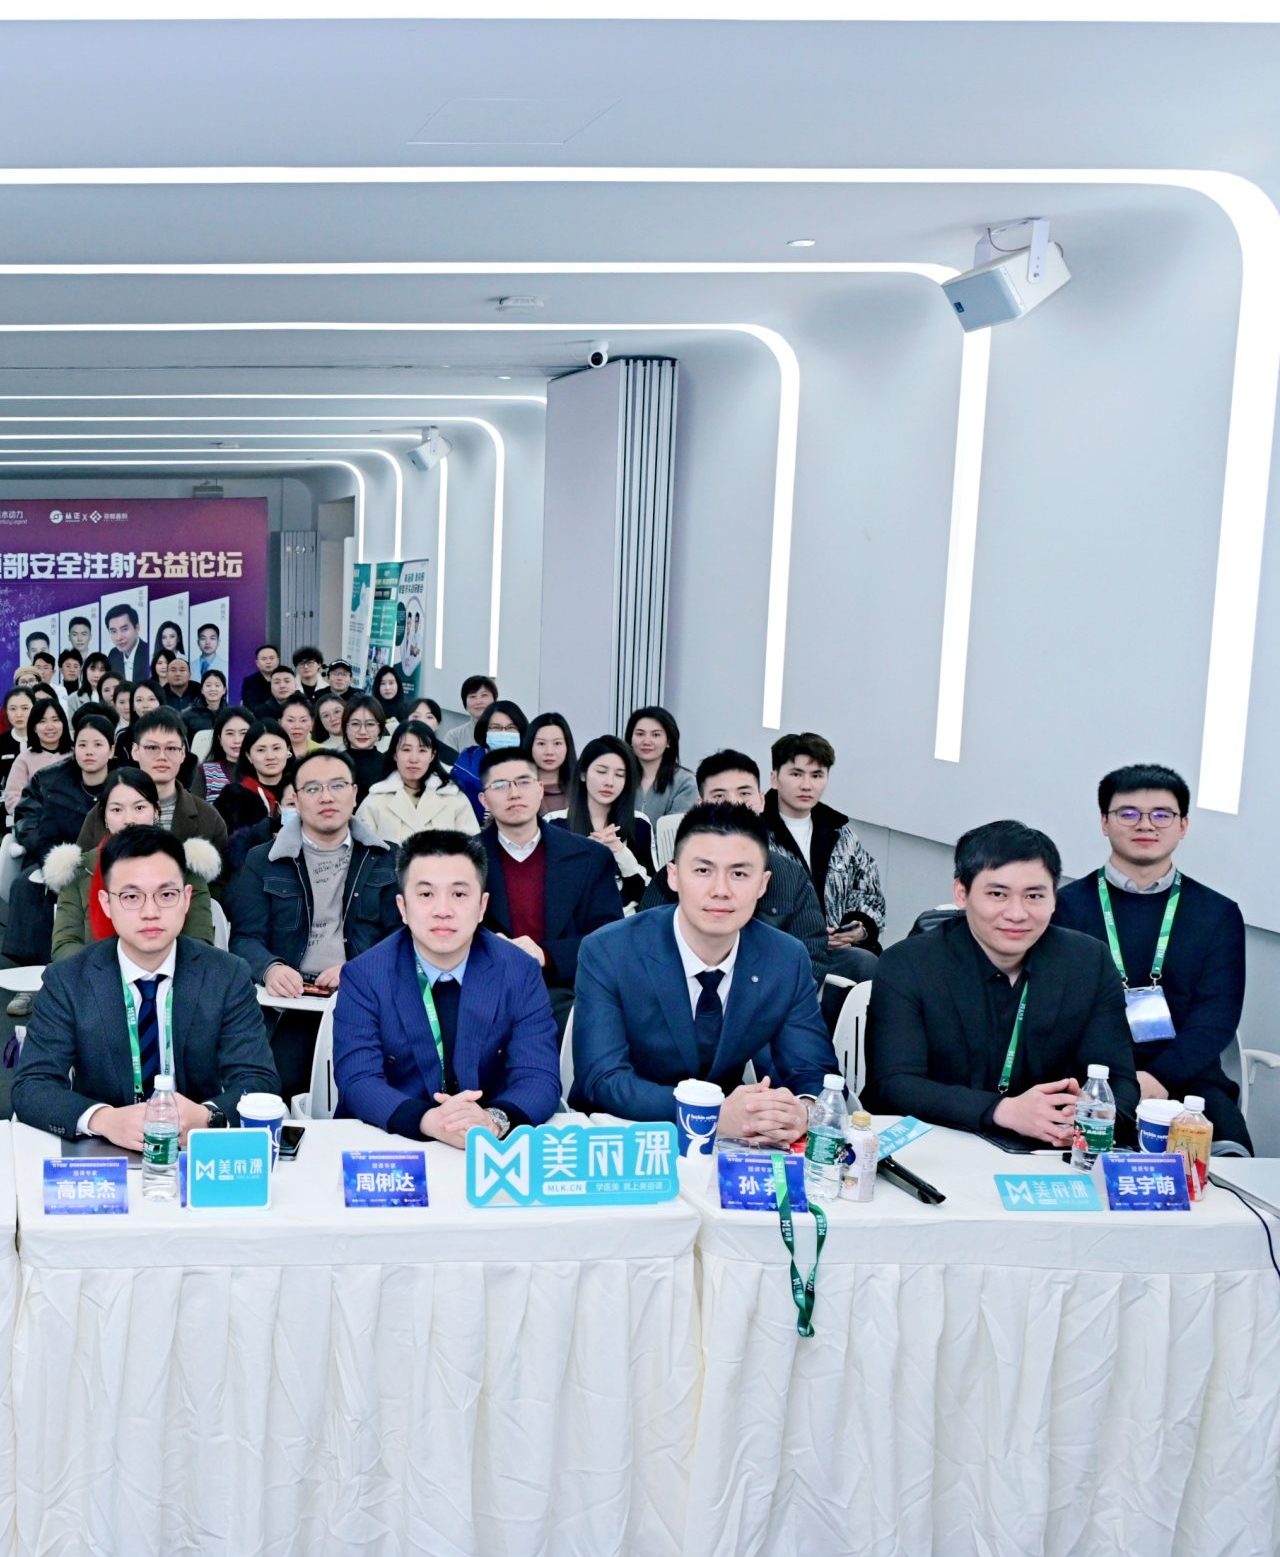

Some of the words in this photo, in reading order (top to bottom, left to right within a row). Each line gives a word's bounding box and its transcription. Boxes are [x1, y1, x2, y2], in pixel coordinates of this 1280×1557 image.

[542, 1131, 672, 1178] 美丽课
[218, 1158, 263, 1175] 美丽课
[56, 1179, 116, 1200] 高良杰
[356, 1172, 416, 1192] 周俐达
[547, 1183, 582, 1192] MLK.CN
[1118, 1176, 1176, 1195] 吴宇萌
